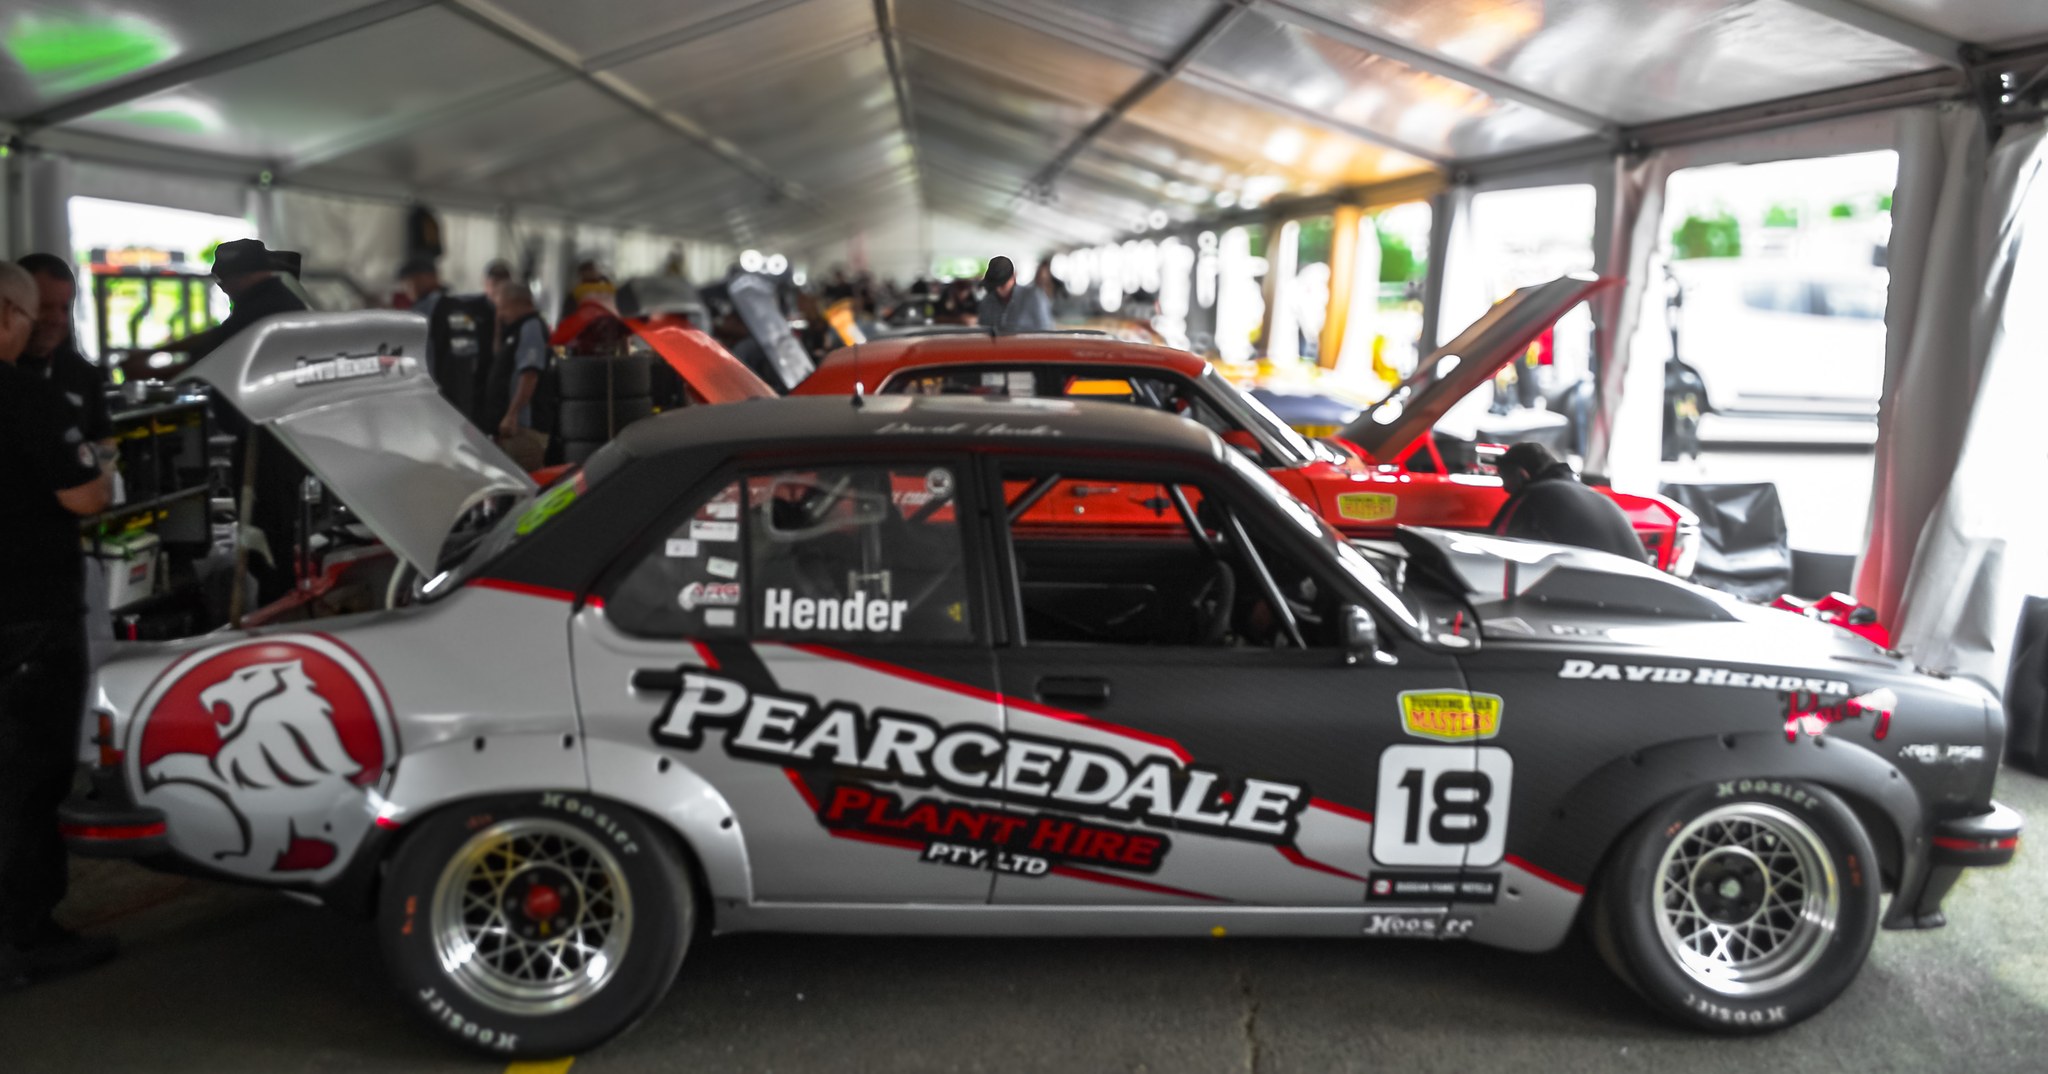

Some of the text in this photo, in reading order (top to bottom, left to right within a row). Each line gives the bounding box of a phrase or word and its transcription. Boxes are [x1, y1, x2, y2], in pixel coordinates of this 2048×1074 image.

[764, 587, 908, 632] Hender
[1558, 659, 1850, 696] DAVID HENDER
[1411, 710, 1493, 732] MASTERS
[659, 673, 1301, 836] PEARCEDALE
[826, 786, 1162, 867] PLANT HIRE
[1397, 767, 1493, 846] 18
[928, 842, 1049, 875] PTY LTD
[1363, 914, 1474, 934] Hooser
